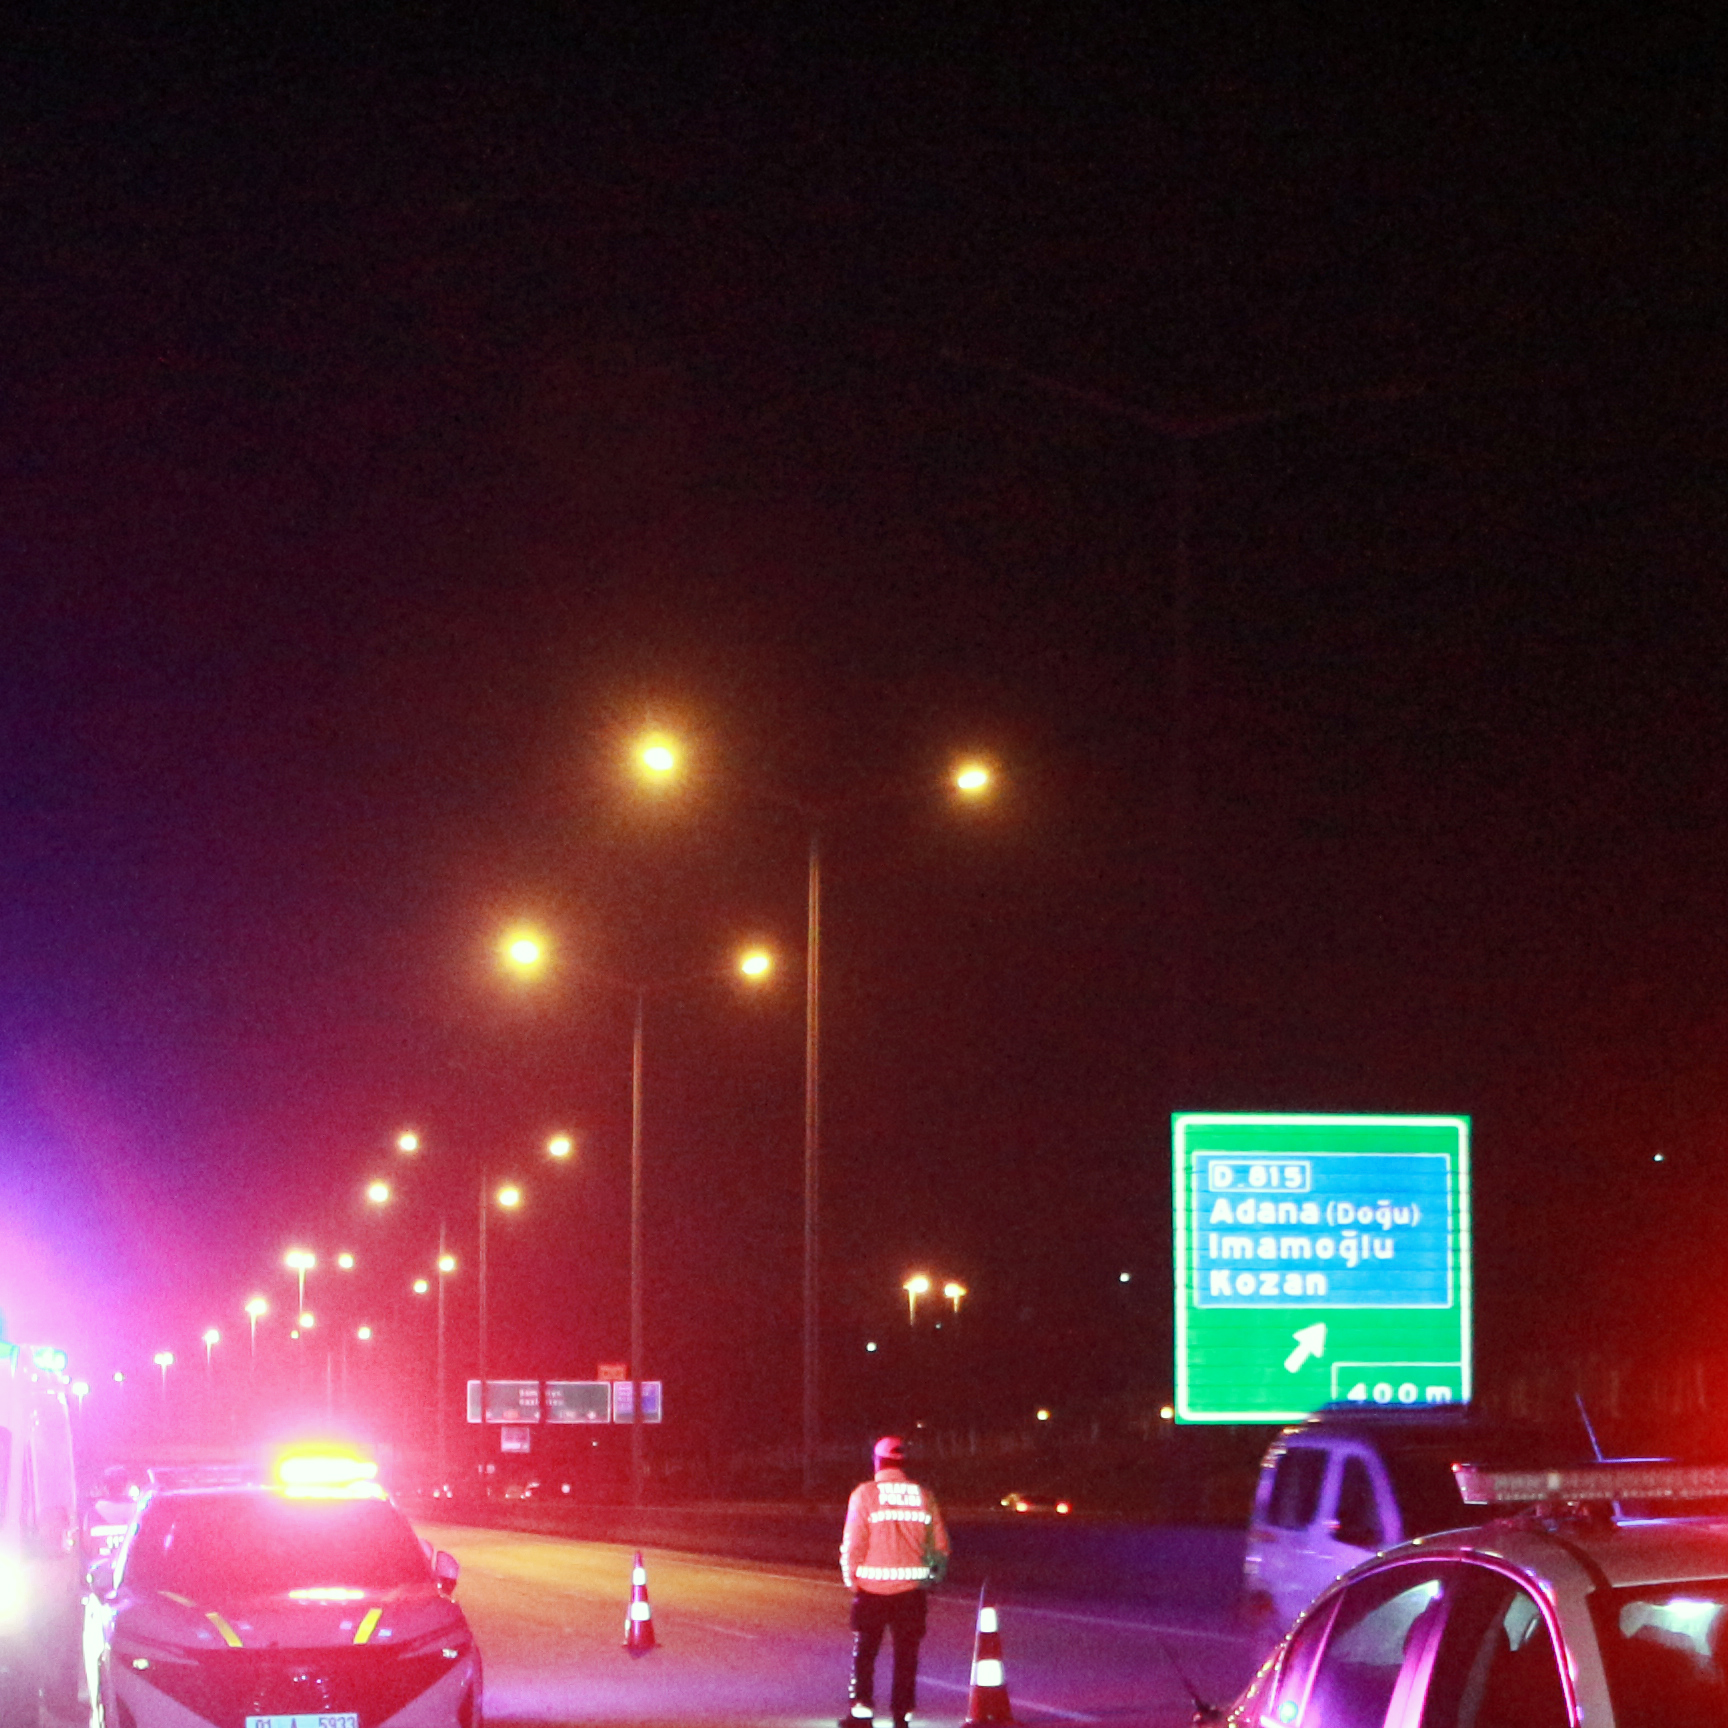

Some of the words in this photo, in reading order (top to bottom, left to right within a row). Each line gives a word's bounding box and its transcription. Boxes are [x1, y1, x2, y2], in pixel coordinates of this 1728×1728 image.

[1209, 1197, 1320, 1225] Adana
[1325, 1200, 1419, 1230] (Doğu)
[1208, 1268, 1328, 1297] Kozan
[1347, 1382, 1418, 1404] 400
[1426, 1385, 1452, 1405] m
